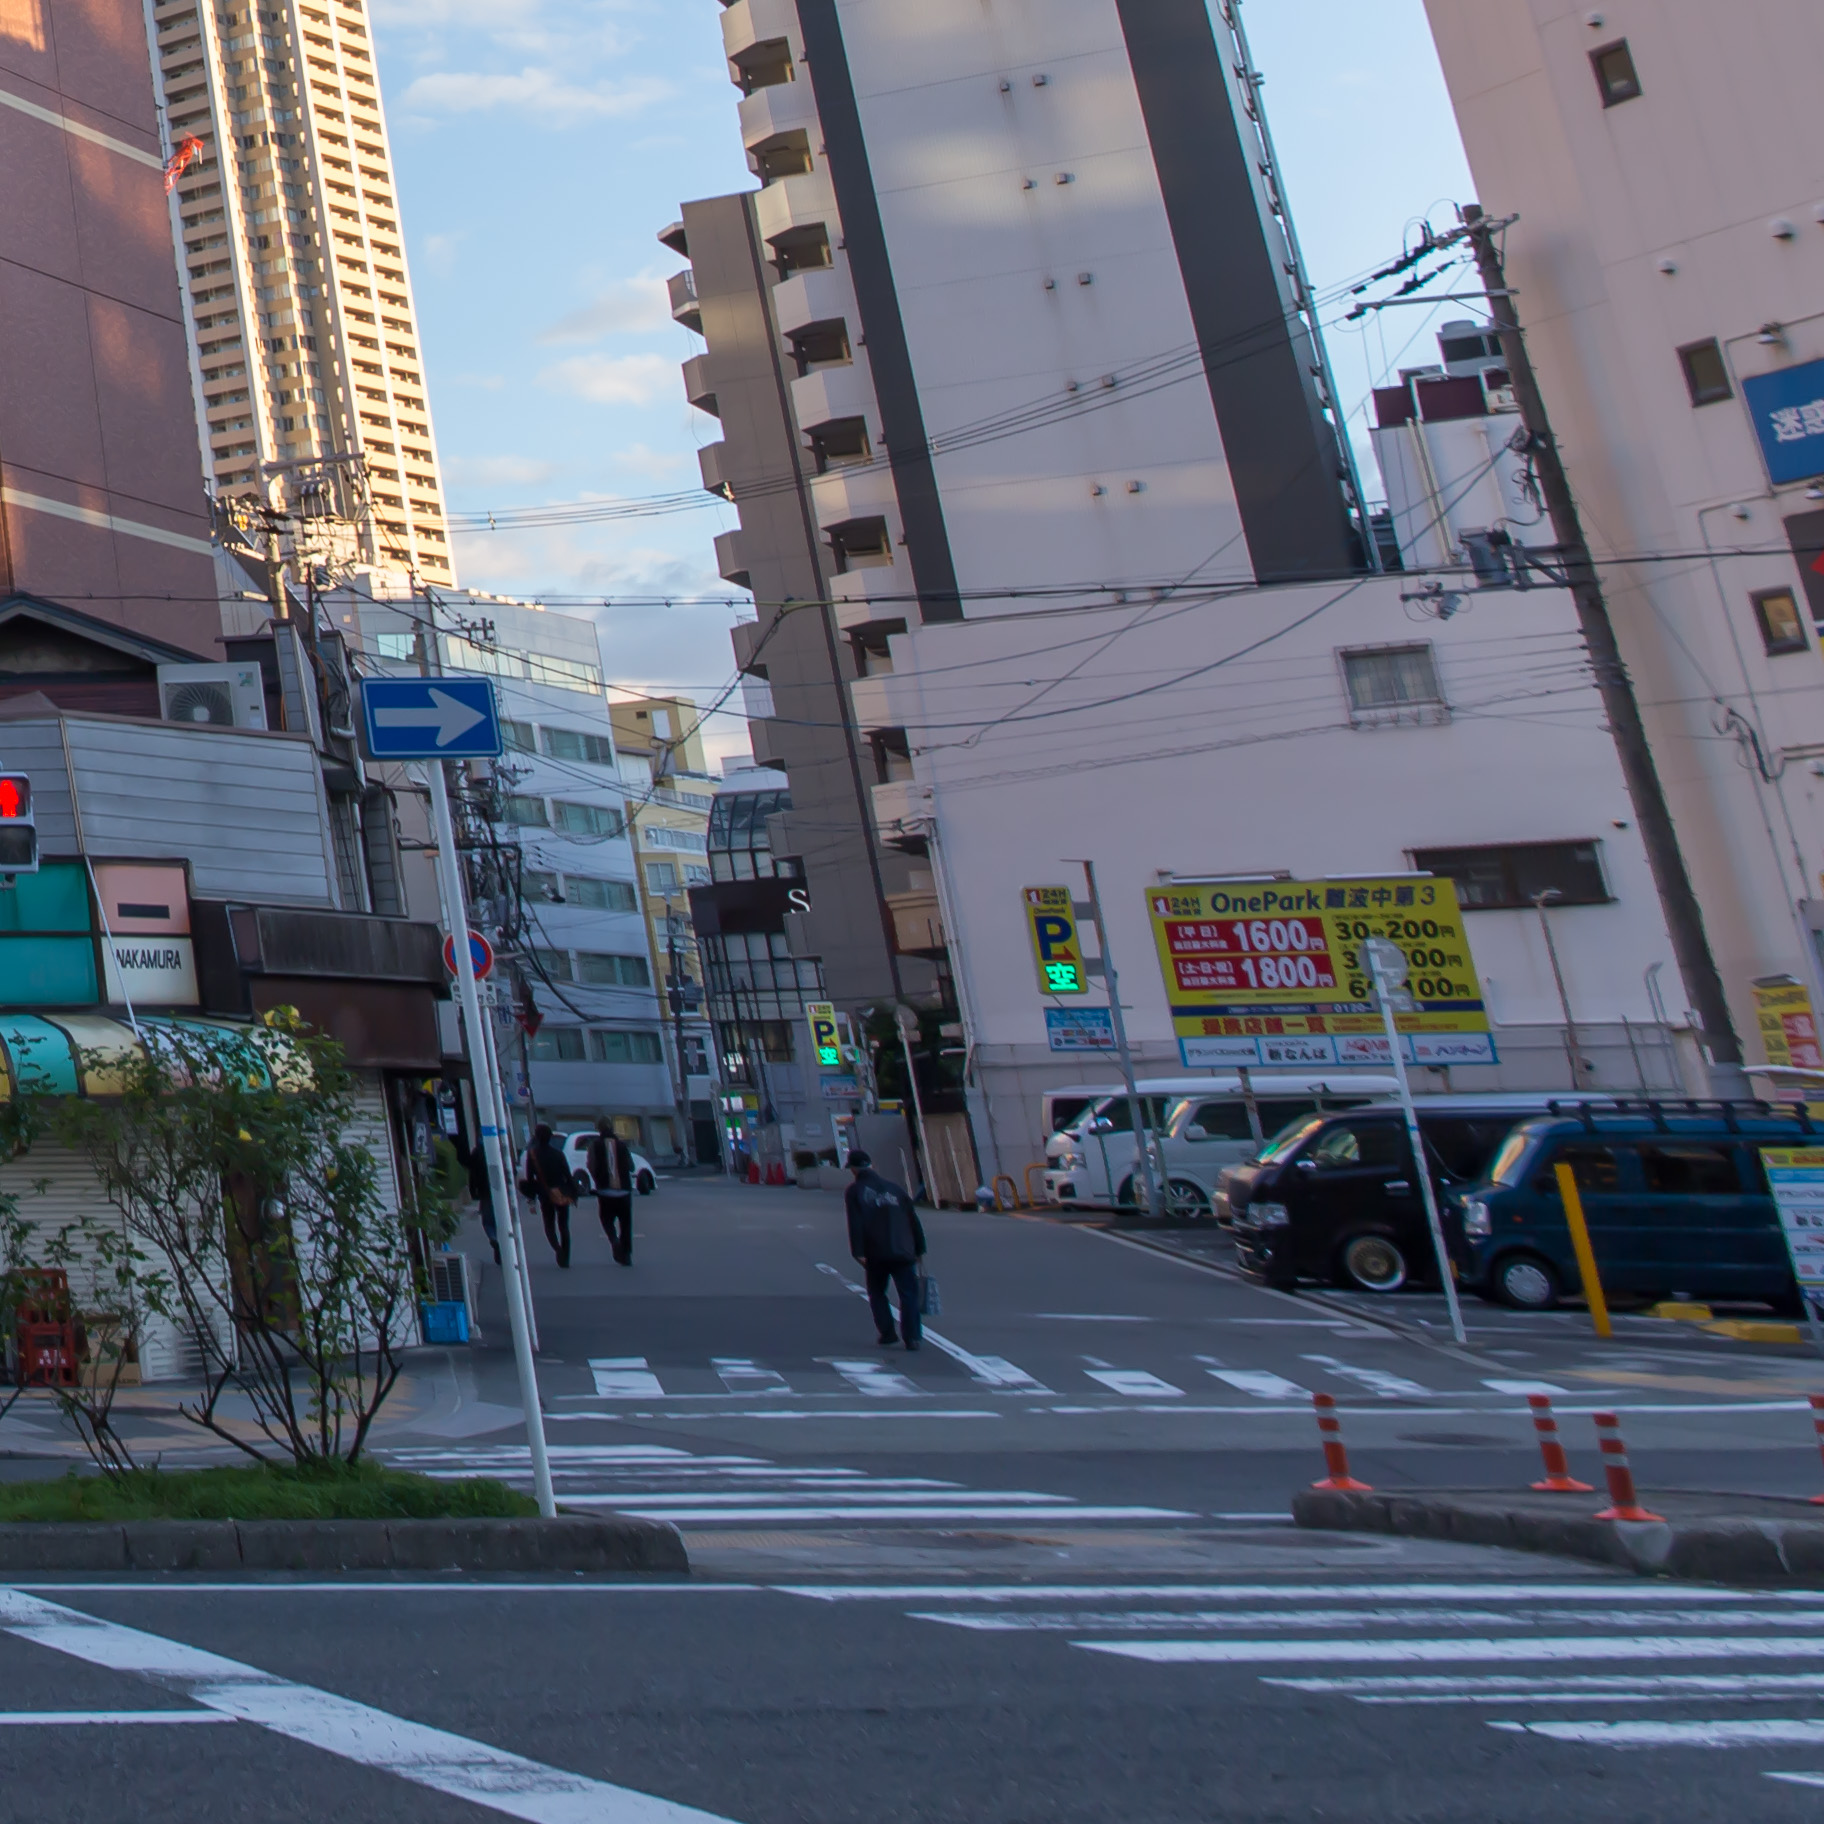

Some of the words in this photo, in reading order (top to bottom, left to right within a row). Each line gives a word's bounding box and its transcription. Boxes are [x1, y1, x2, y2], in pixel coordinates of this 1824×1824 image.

[1211, 888, 1322, 913] OnePark
[1034, 915, 1073, 961] P
[1232, 919, 1326, 952] 1600円
[116, 948, 182, 970] NAKAMURA
[1240, 955, 1335, 989] 1800円
[1044, 961, 1080, 992] 空
[814, 1020, 835, 1046] P
